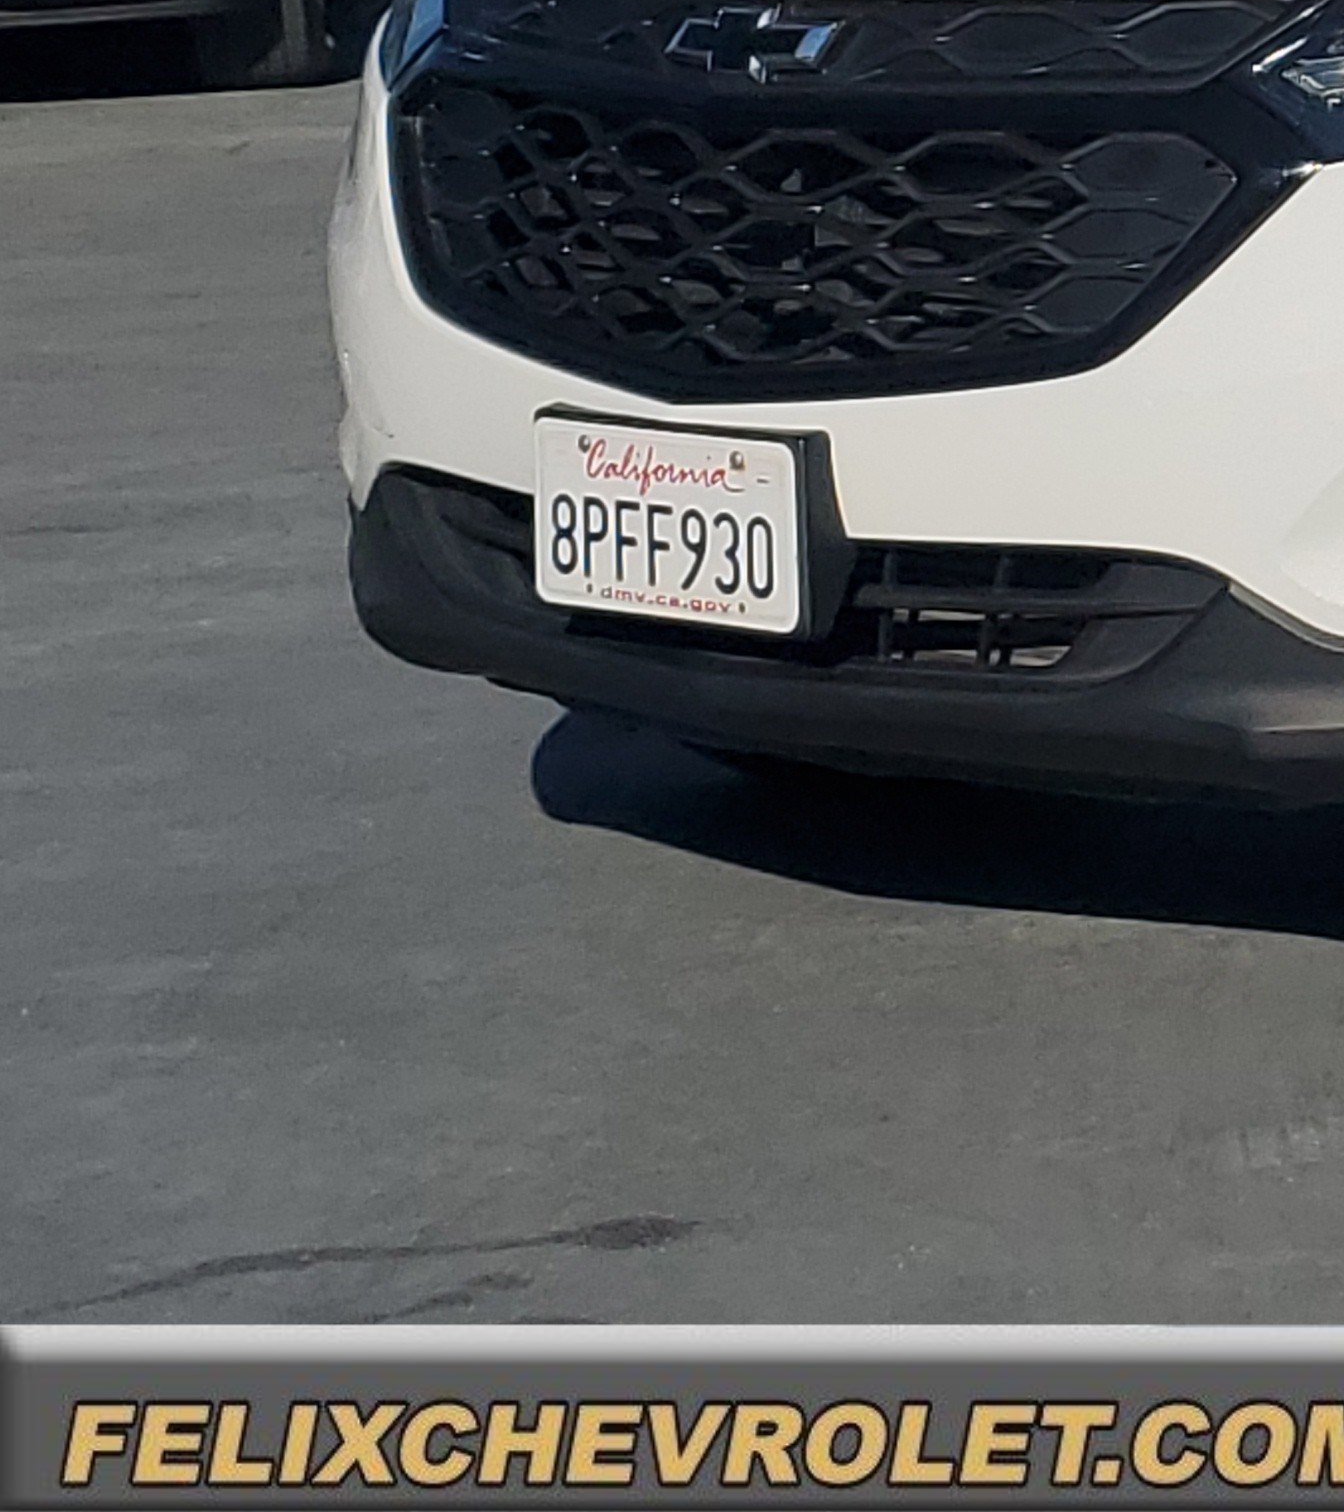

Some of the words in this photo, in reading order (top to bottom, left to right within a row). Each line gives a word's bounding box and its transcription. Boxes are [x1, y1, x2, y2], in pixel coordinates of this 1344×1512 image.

[584, 438, 745, 496] California
[551, 493, 774, 600] 8PFF930
[601, 586, 733, 614] dmv.ca.gov
